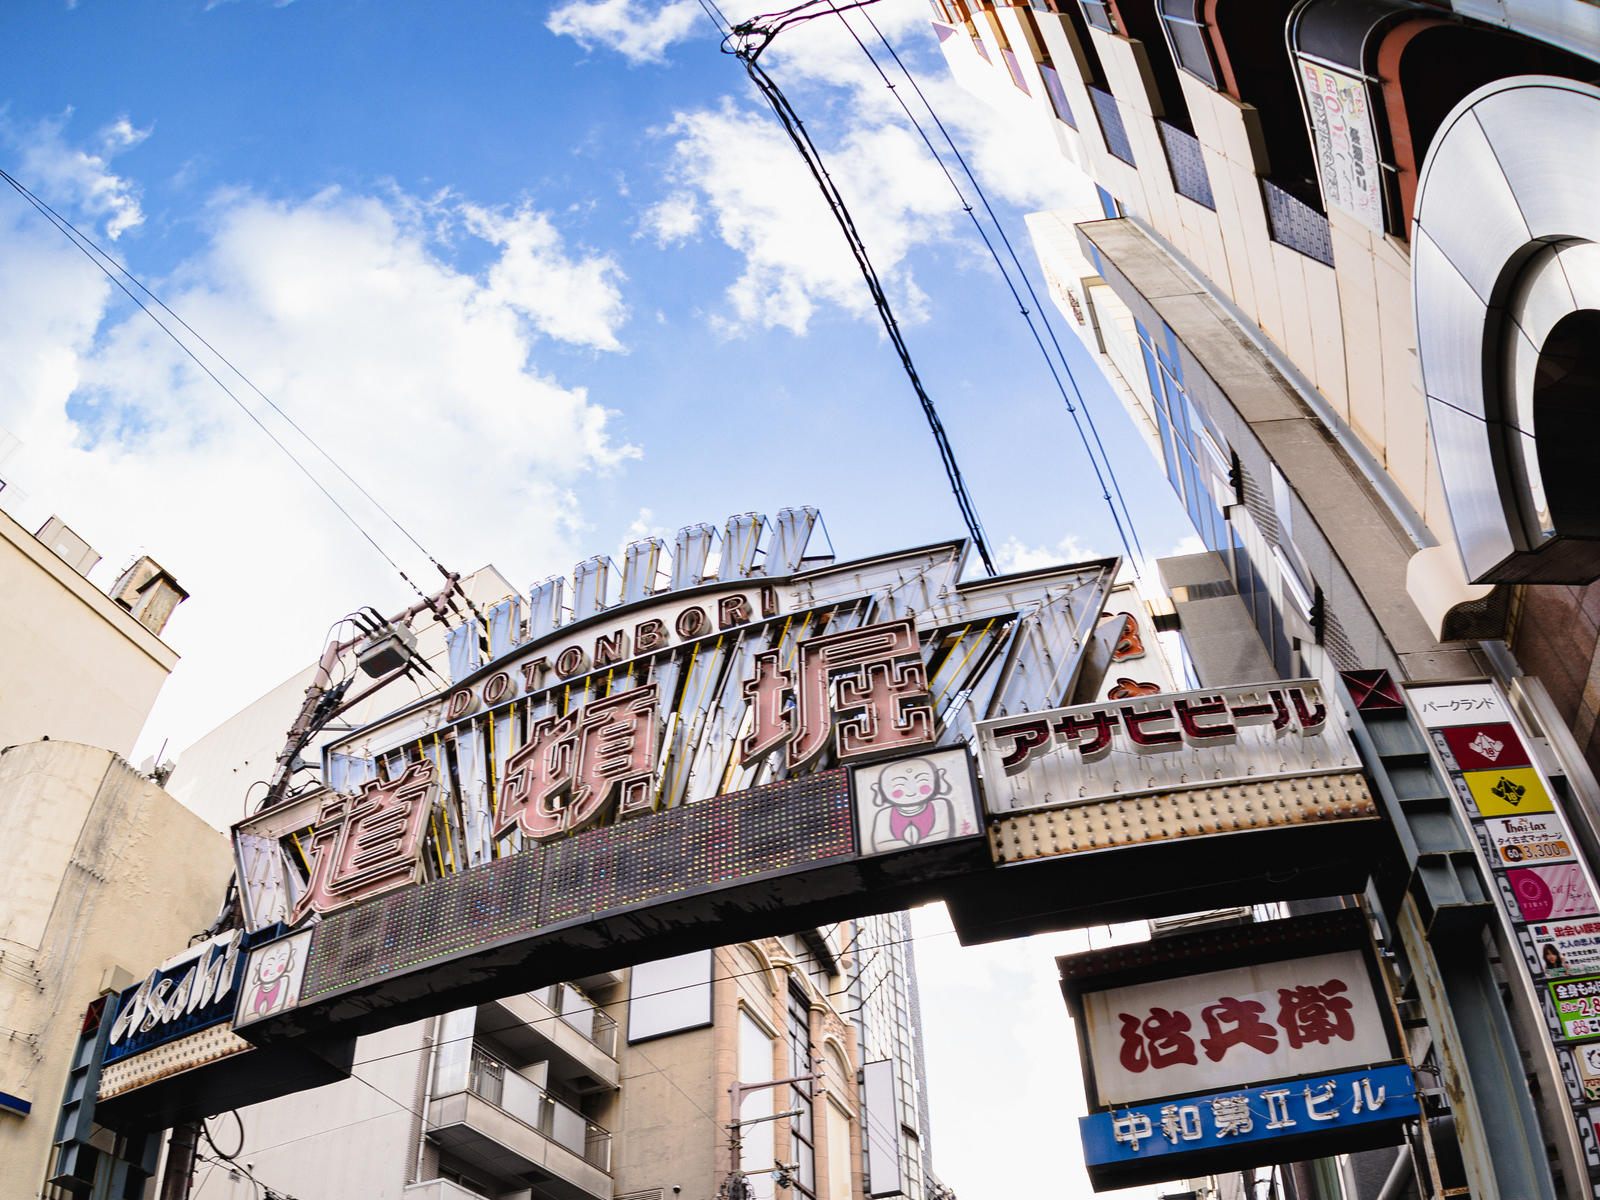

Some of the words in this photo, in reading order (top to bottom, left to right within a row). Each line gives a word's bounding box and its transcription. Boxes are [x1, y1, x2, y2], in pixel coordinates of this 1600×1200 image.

[446, 584, 779, 721] DOTONBORI
[290, 617, 937, 926] 道頓堀
[993, 688, 1326, 776] アサヒビール
[1497, 832, 1563, 846] タイ古式マッサージ
[110, 929, 244, 1045] Asahi
[1118, 979, 1355, 1073] 治兵衛
